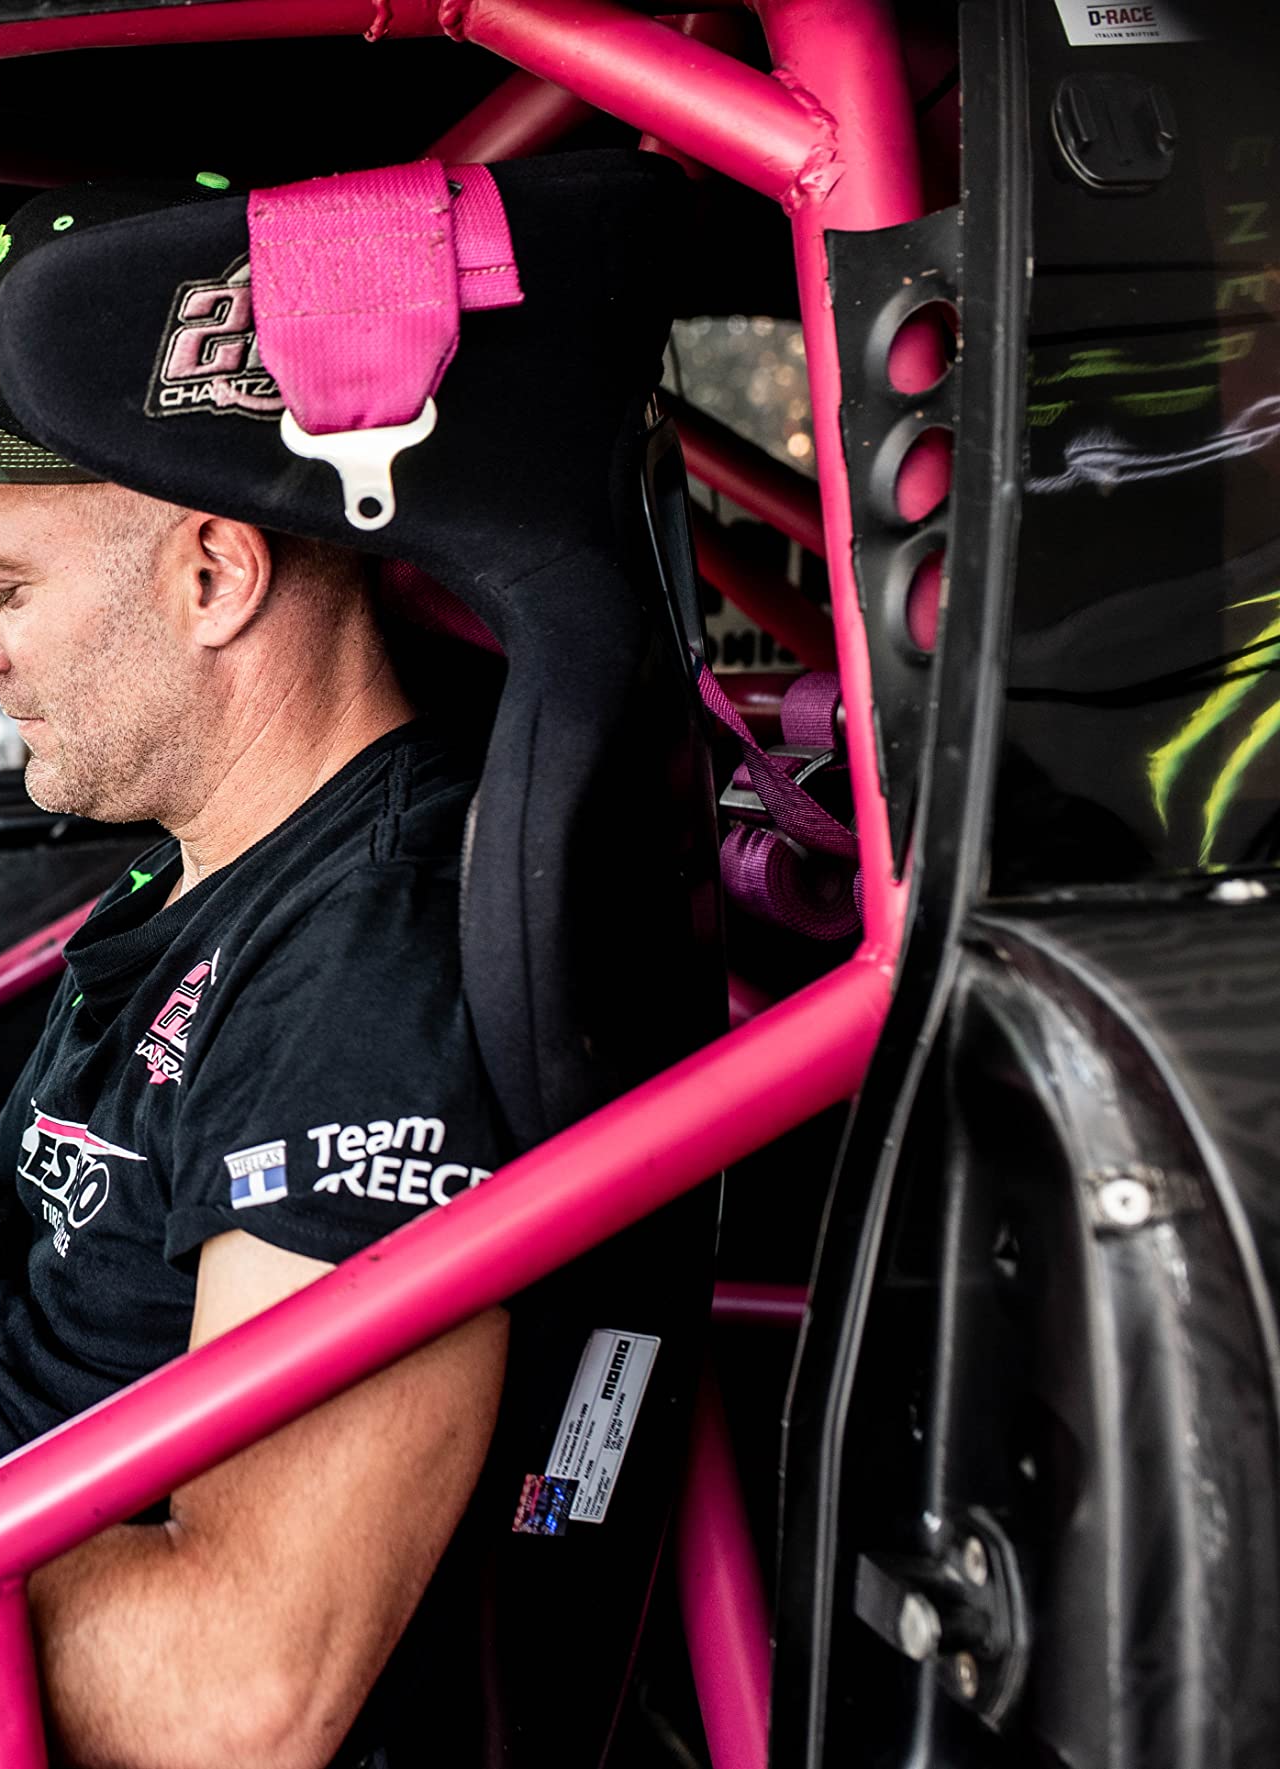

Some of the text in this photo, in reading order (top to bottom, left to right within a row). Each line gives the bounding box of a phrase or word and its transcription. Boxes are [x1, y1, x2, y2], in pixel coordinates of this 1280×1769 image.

[1088, 6, 1154, 26] D-RACE
[159, 377, 282, 407] CHANTZ
[307, 1115, 446, 1169] Team
[600, 1338, 631, 1401] momo
